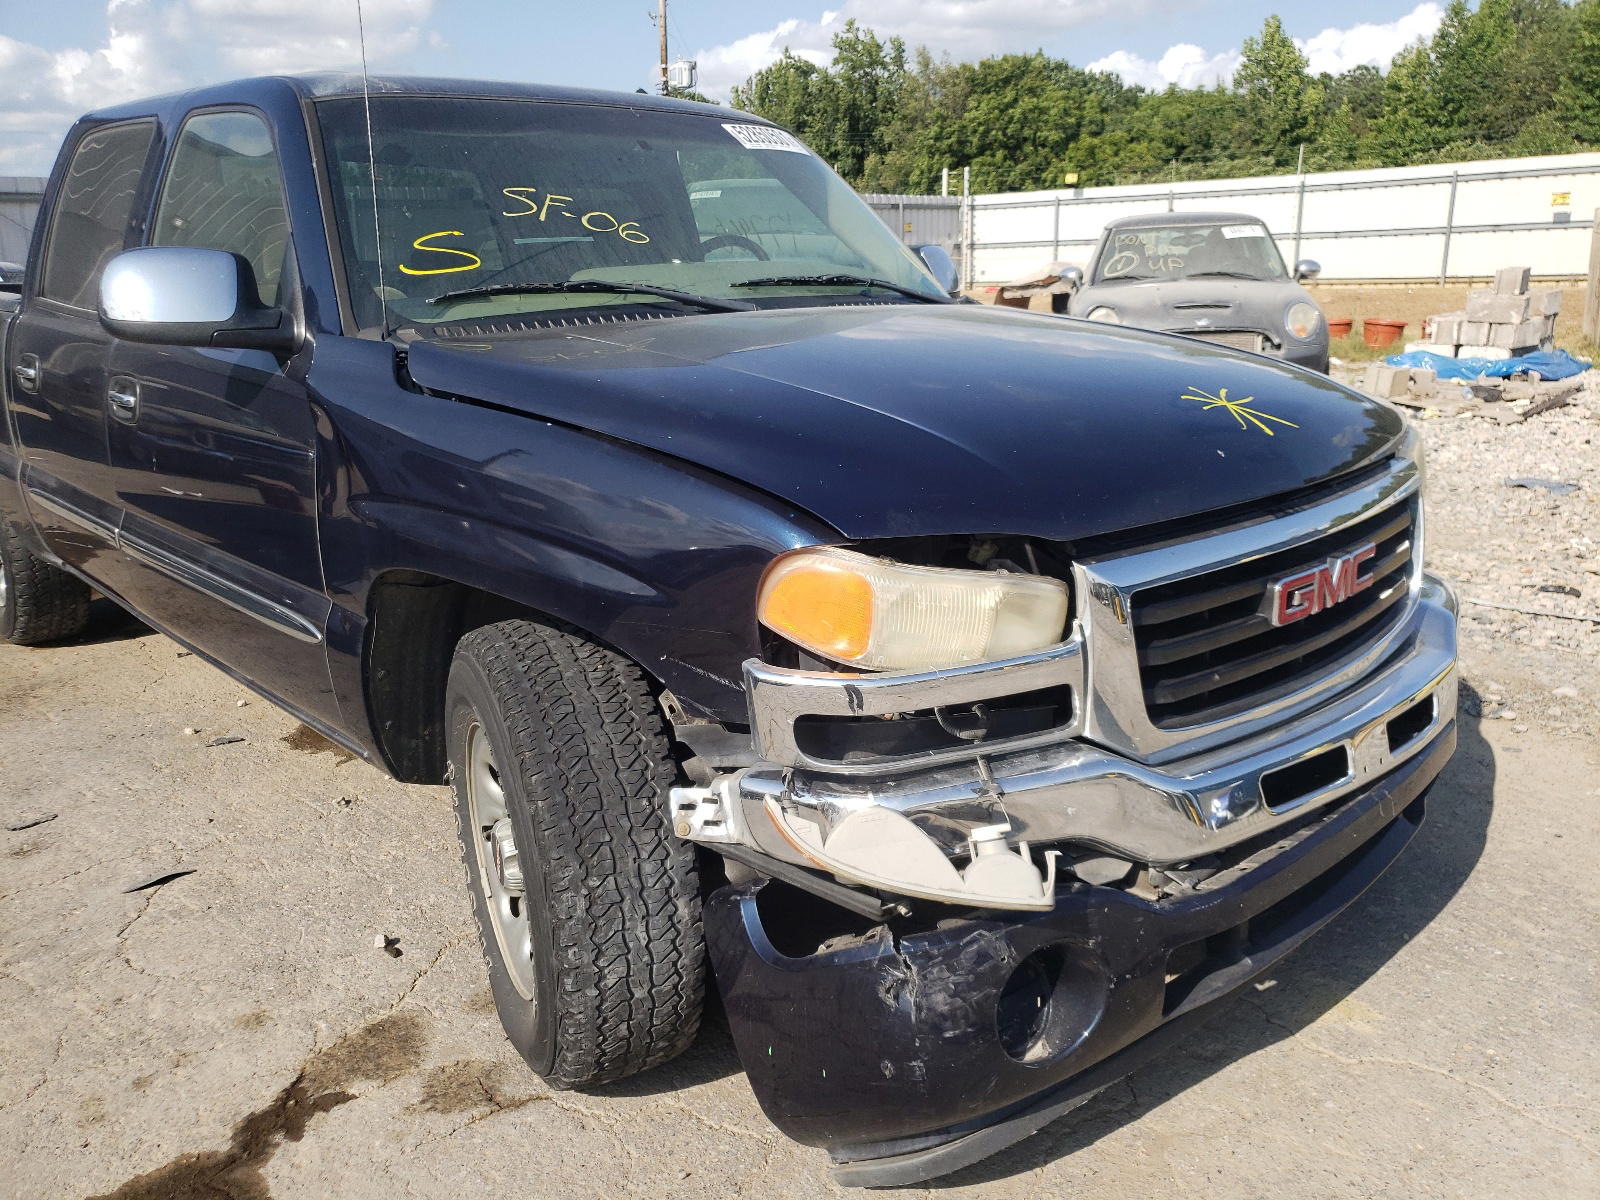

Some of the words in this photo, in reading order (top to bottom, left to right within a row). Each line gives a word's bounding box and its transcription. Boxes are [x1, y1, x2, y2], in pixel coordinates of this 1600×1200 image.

[503, 187, 649, 244] SF-06
[400, 231, 481, 275] S
[1271, 541, 1377, 628] GMC
